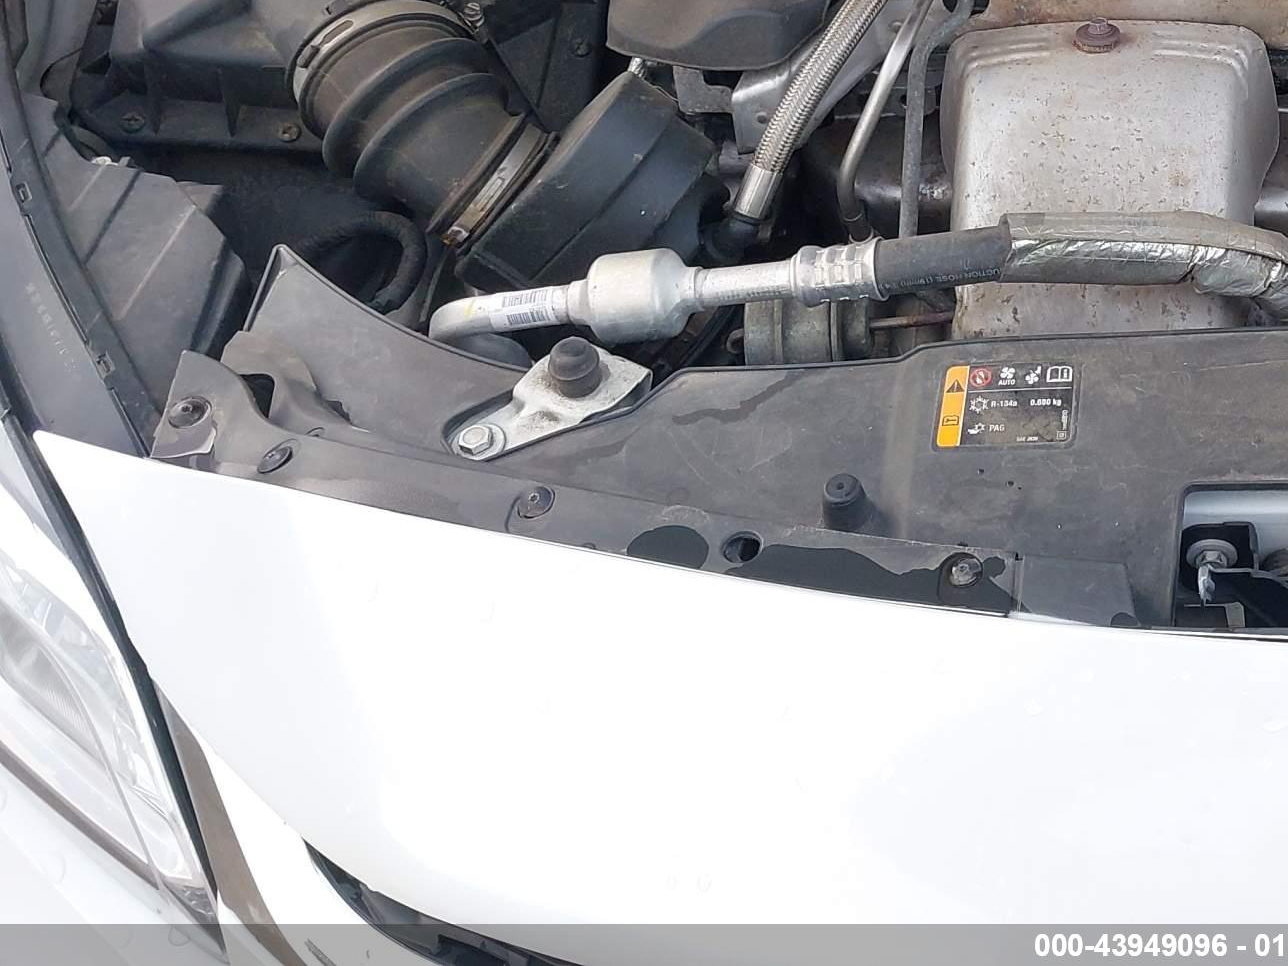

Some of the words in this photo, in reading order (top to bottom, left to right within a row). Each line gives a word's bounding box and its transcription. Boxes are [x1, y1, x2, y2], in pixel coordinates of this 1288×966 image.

[990, 398, 1018, 407] R-134a
[1052, 398, 1062, 407] kg
[989, 424, 1005, 432] PAG
